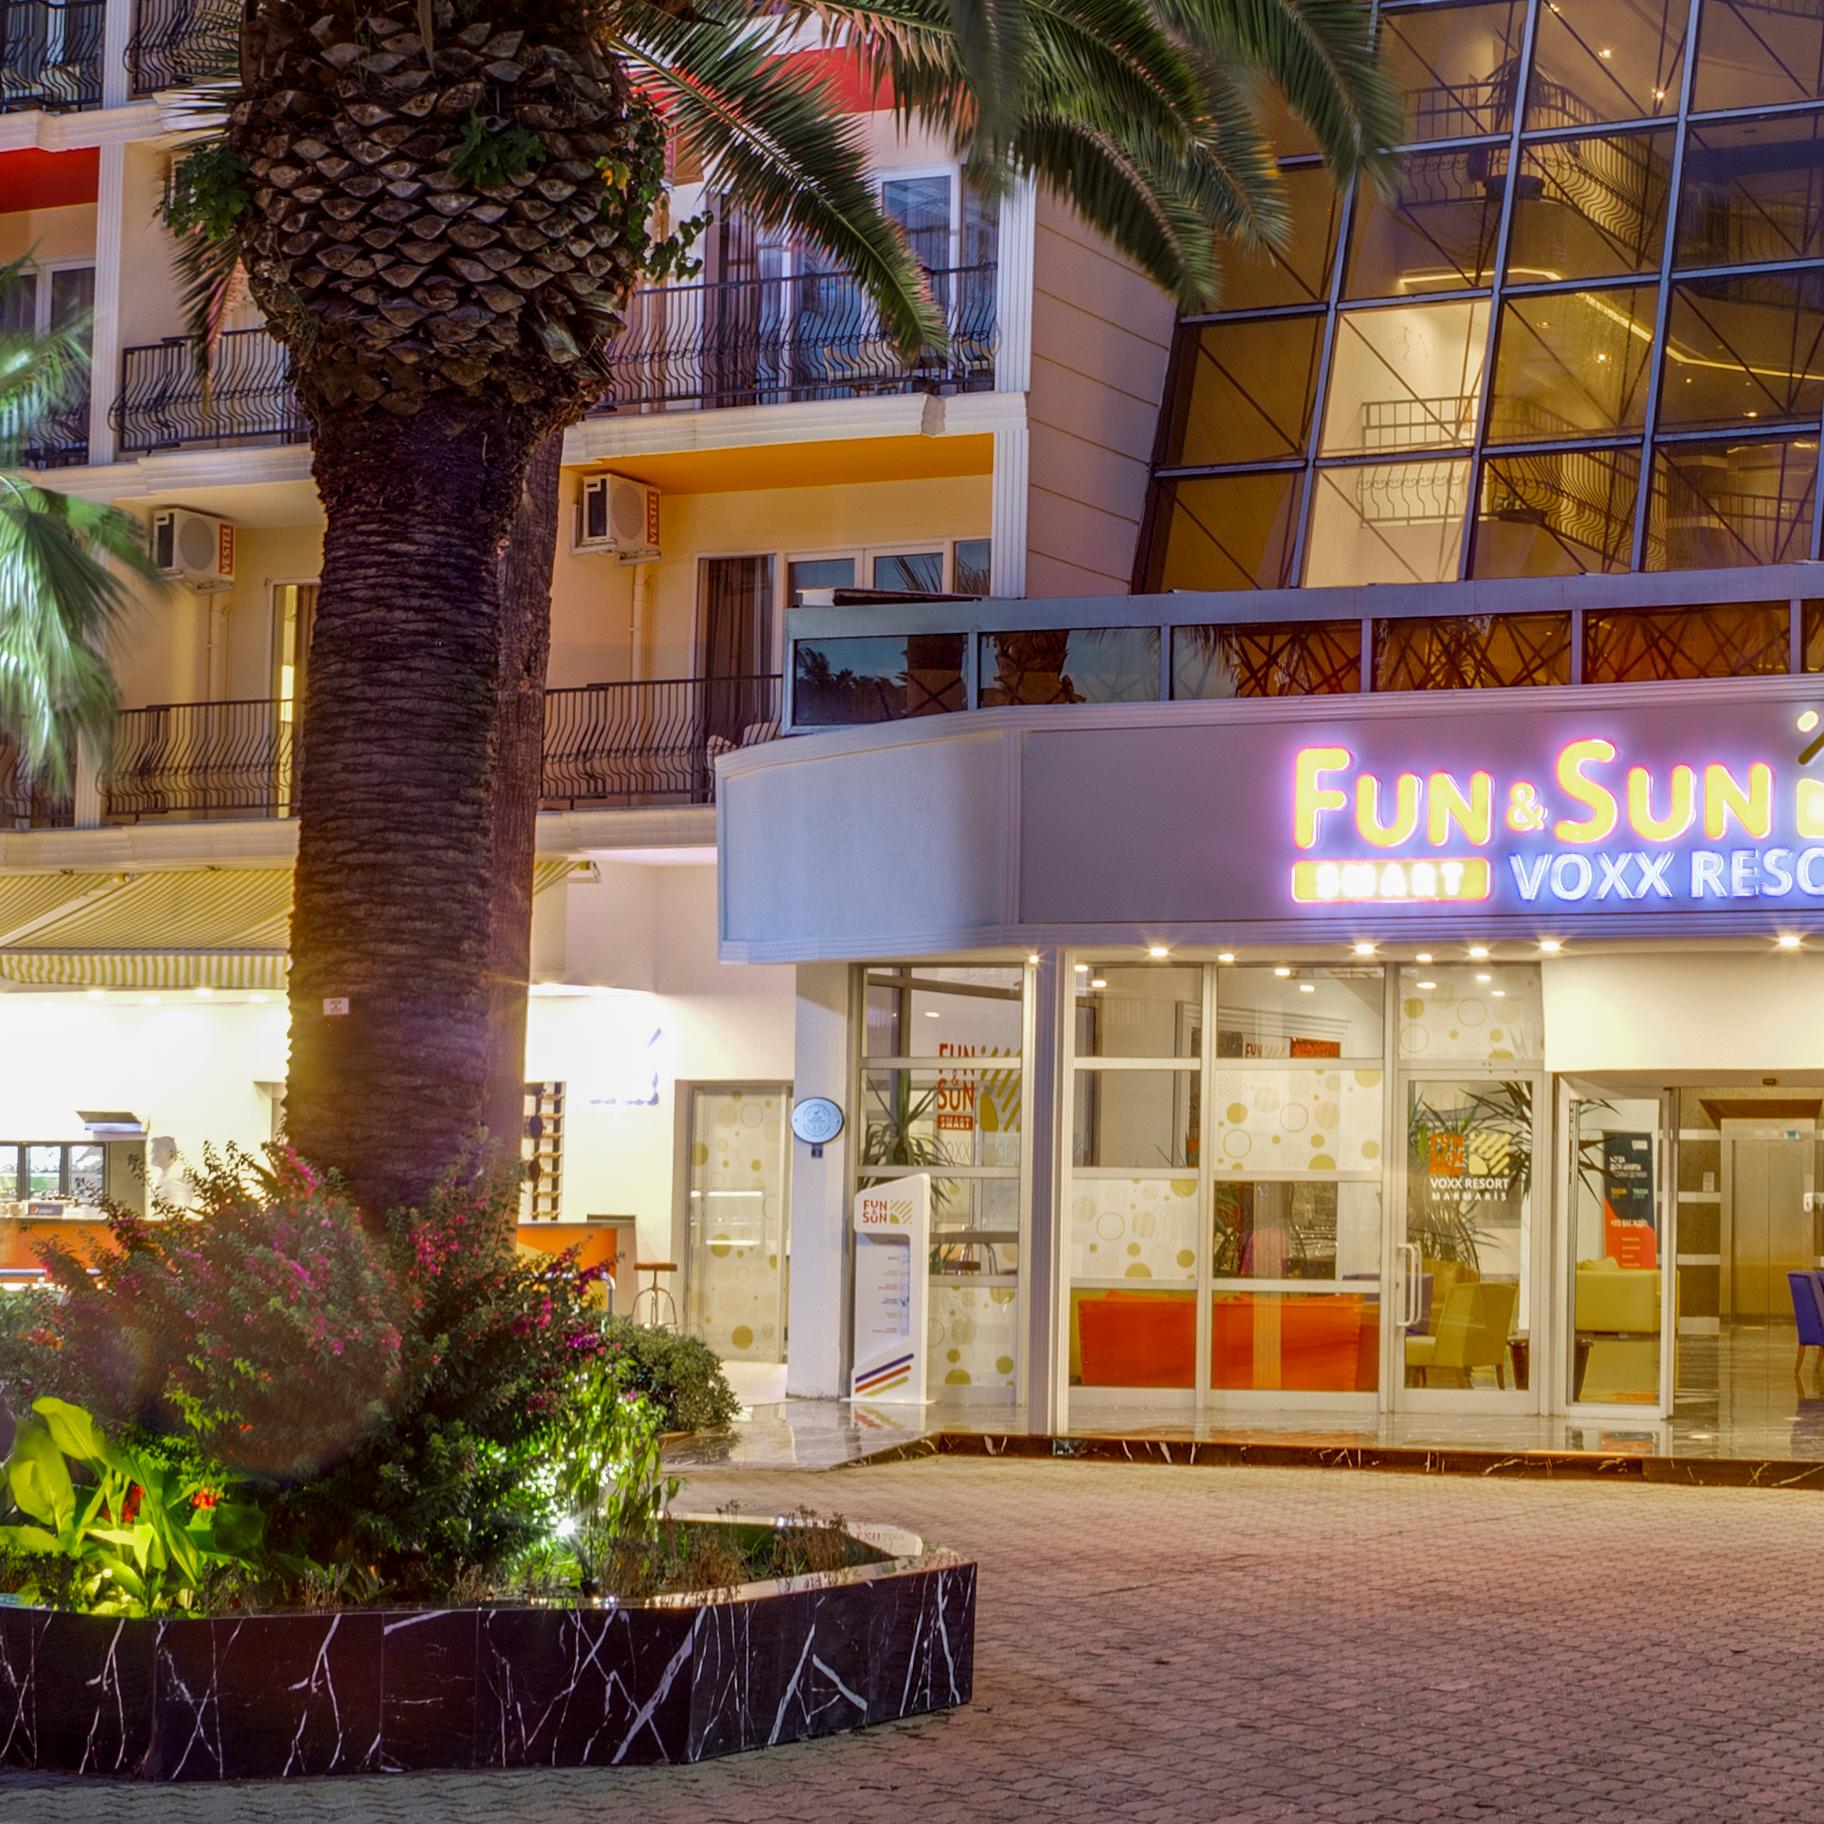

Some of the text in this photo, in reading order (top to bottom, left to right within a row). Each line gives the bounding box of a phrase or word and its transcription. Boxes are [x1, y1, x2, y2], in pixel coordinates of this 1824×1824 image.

[649, 495, 658, 543] VESTEL
[221, 527, 232, 573] VESTEL
[1315, 861, 1464, 899] SMART
[1508, 852, 1676, 901] VOXX
[937, 1078, 975, 1111] SUN
[940, 1117, 971, 1128] SMART
[1430, 1177, 1510, 1189] VOXX RESORT
[863, 1200, 887, 1211] FUN
[863, 1212, 887, 1224] SUN
